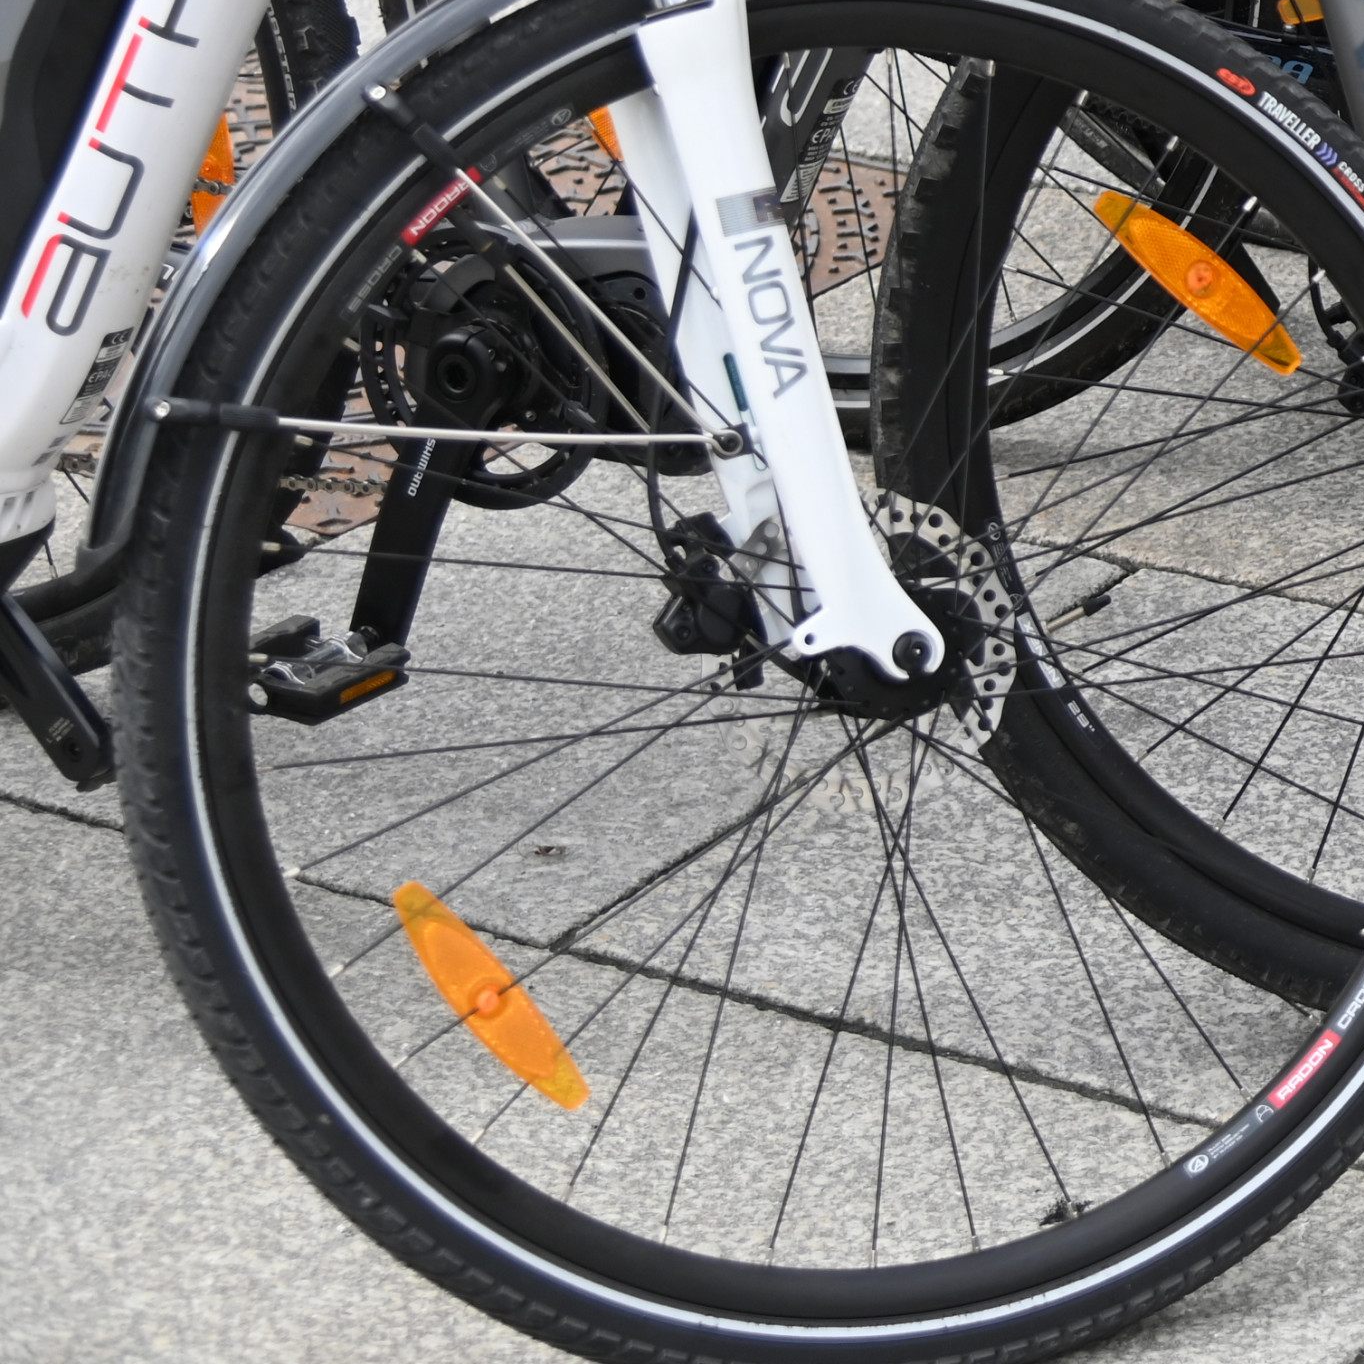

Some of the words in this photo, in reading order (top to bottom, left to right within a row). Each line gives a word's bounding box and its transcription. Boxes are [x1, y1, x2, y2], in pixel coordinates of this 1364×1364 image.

[1257, 90, 1322, 150] TRAVELLER
[407, 436, 437, 497] SHIMANO
[1276, 1038, 1334, 1101] RADON
